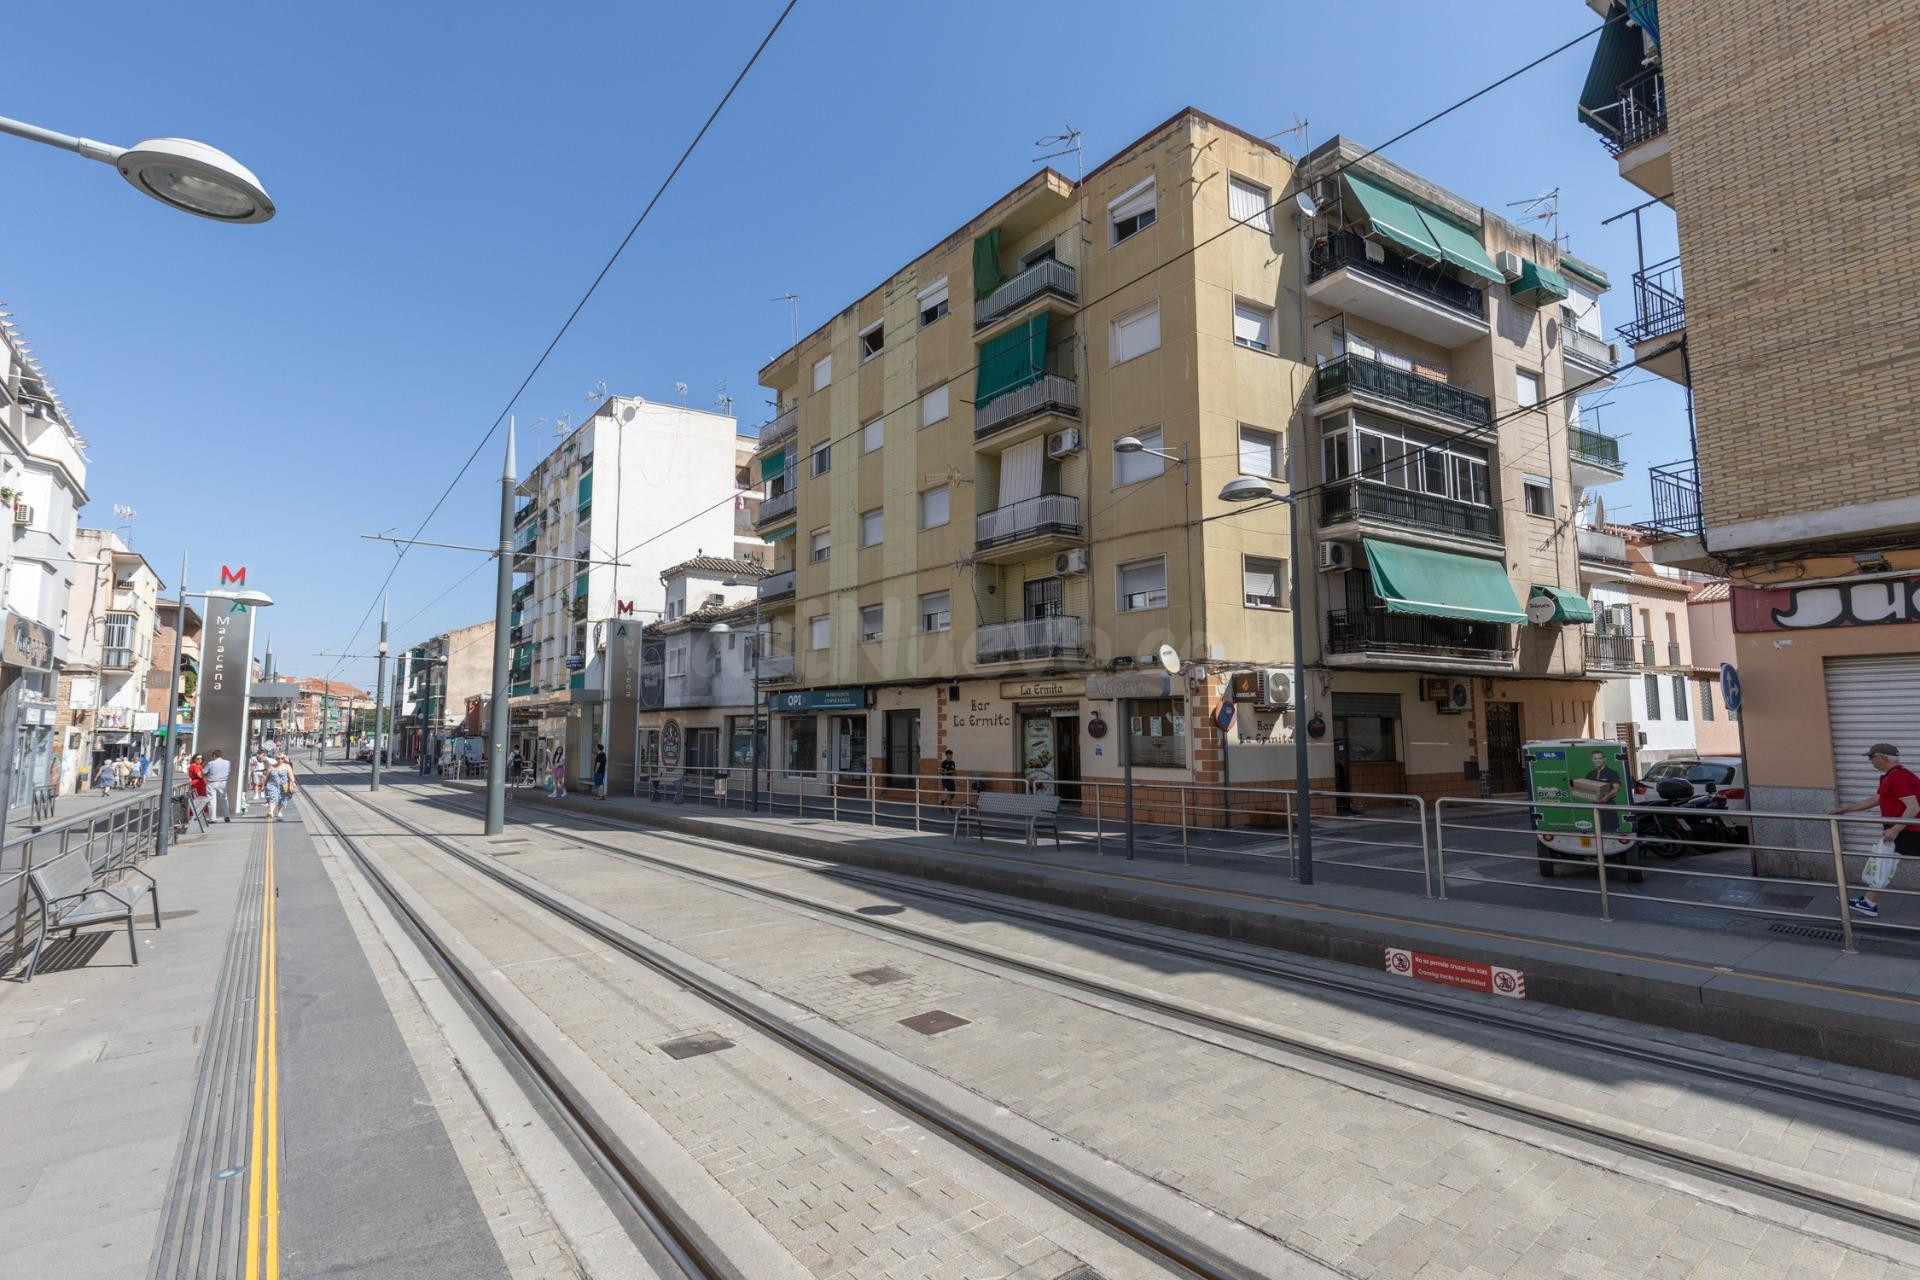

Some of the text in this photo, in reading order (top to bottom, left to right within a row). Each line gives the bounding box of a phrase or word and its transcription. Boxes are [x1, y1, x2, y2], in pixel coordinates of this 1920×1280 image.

[220, 564, 246, 586] M
[617, 599, 634, 615] M
[1771, 578, 1920, 629] Ju
[213, 616, 230, 690] Maracena
[1020, 682, 1063, 696] La Ermita
[787, 695, 802, 706] OPI
[971, 699, 990, 712] Bar
[953, 713, 1011, 727] La Ermita
[1255, 732, 1294, 745] Ermita
[1430, 960, 1449, 969] permite
[1450, 963, 1467, 971] cruzar
[1467, 965, 1475, 973] las
